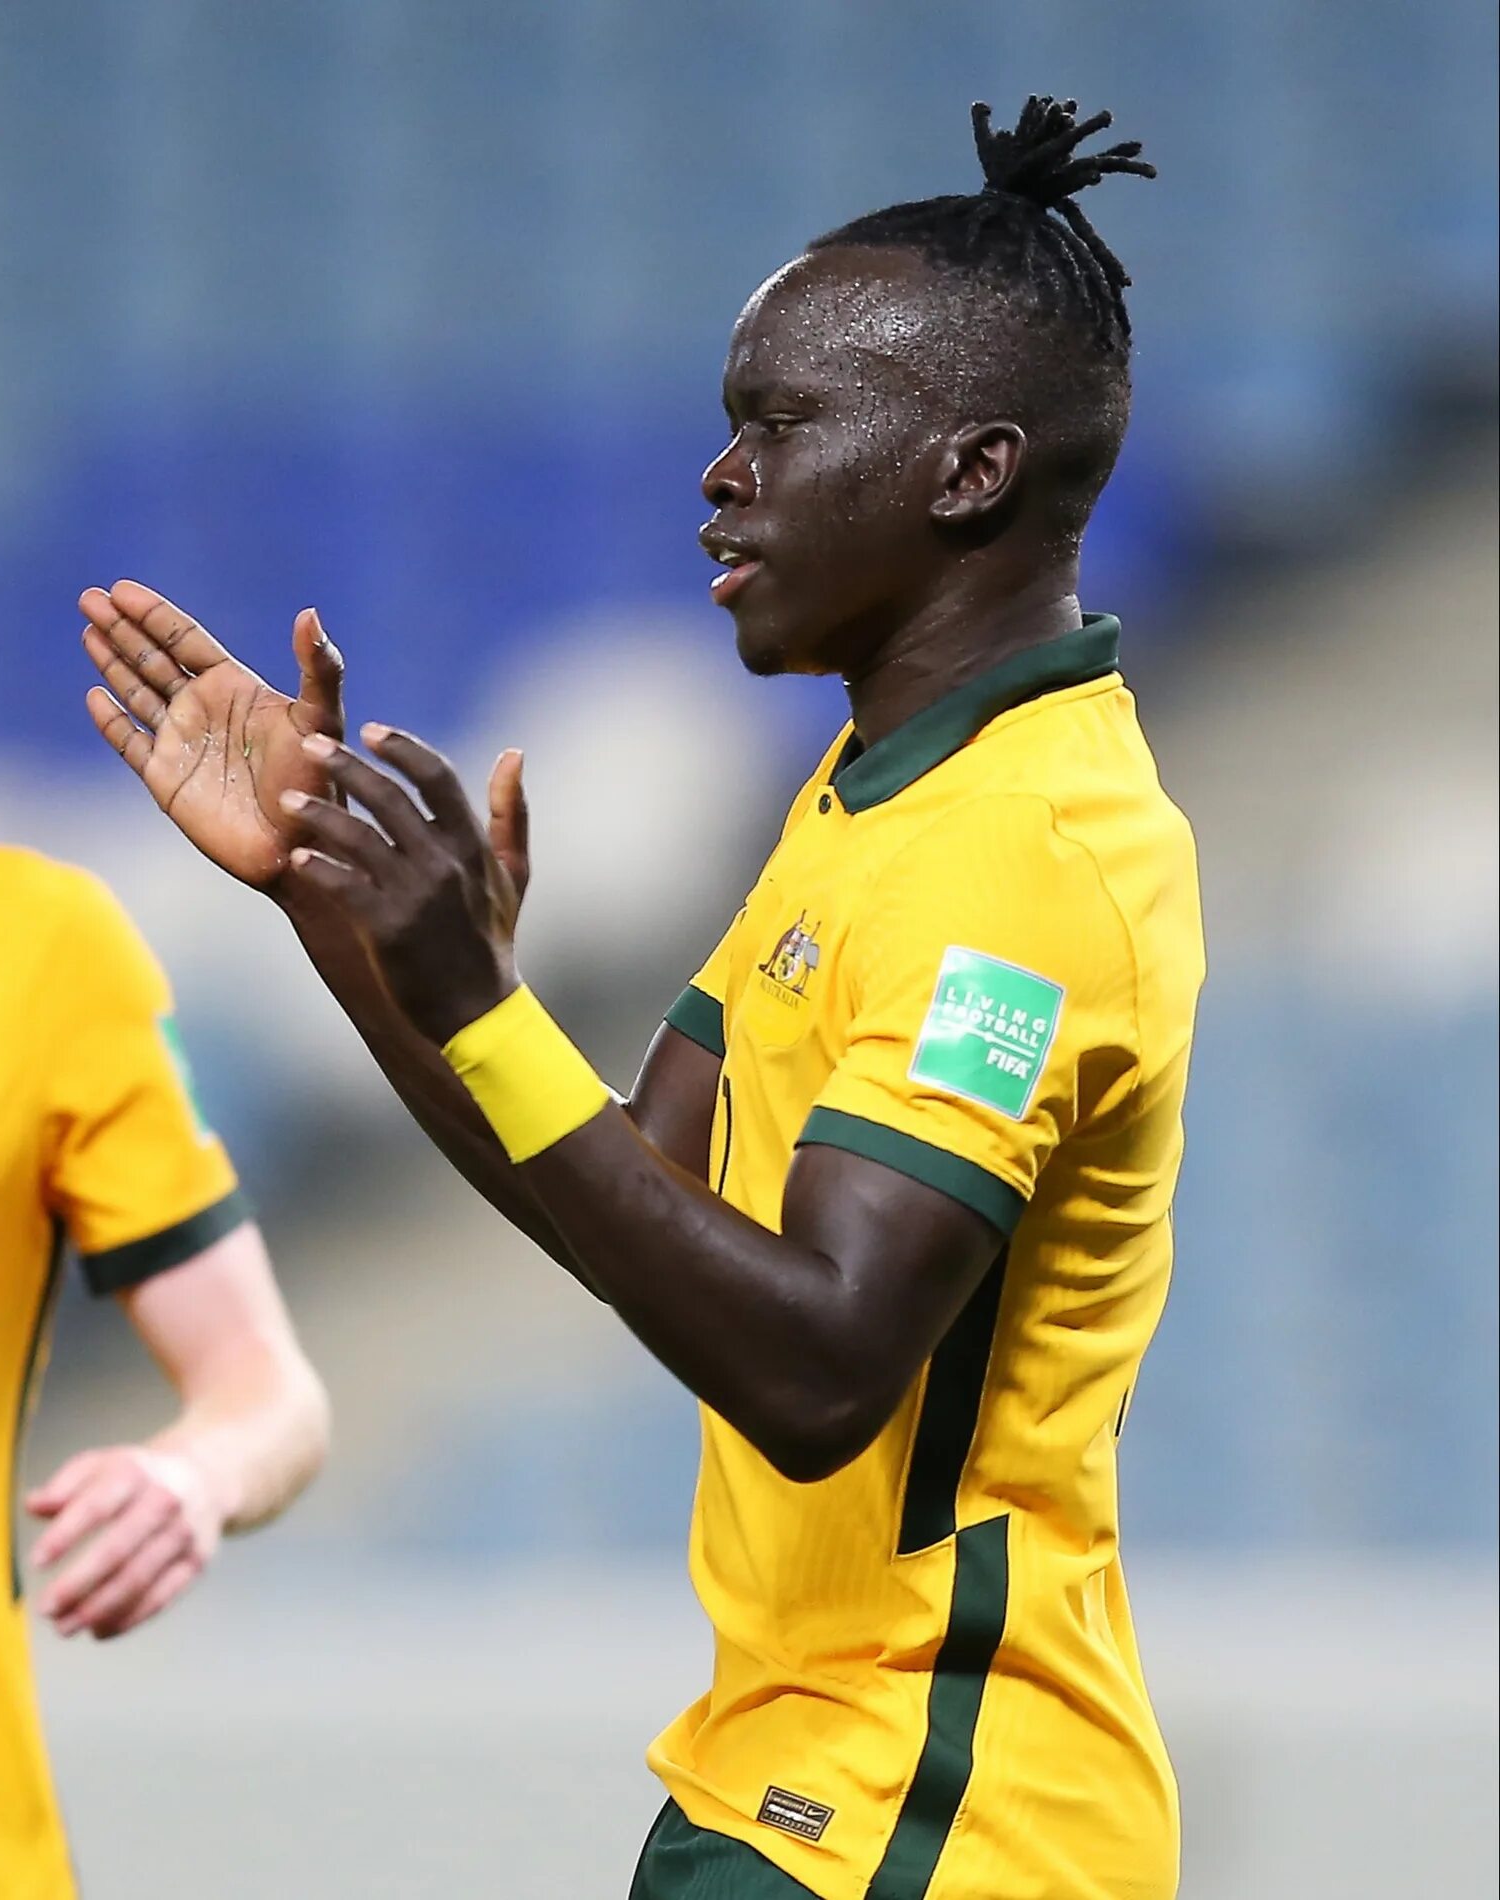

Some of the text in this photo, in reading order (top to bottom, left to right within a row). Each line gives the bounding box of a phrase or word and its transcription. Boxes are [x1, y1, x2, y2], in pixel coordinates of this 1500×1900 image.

[942, 1001, 1040, 1049] FOOTBALL
[946, 986, 1047, 1034] LIVING
[986, 1048, 1031, 1080] FIFA
